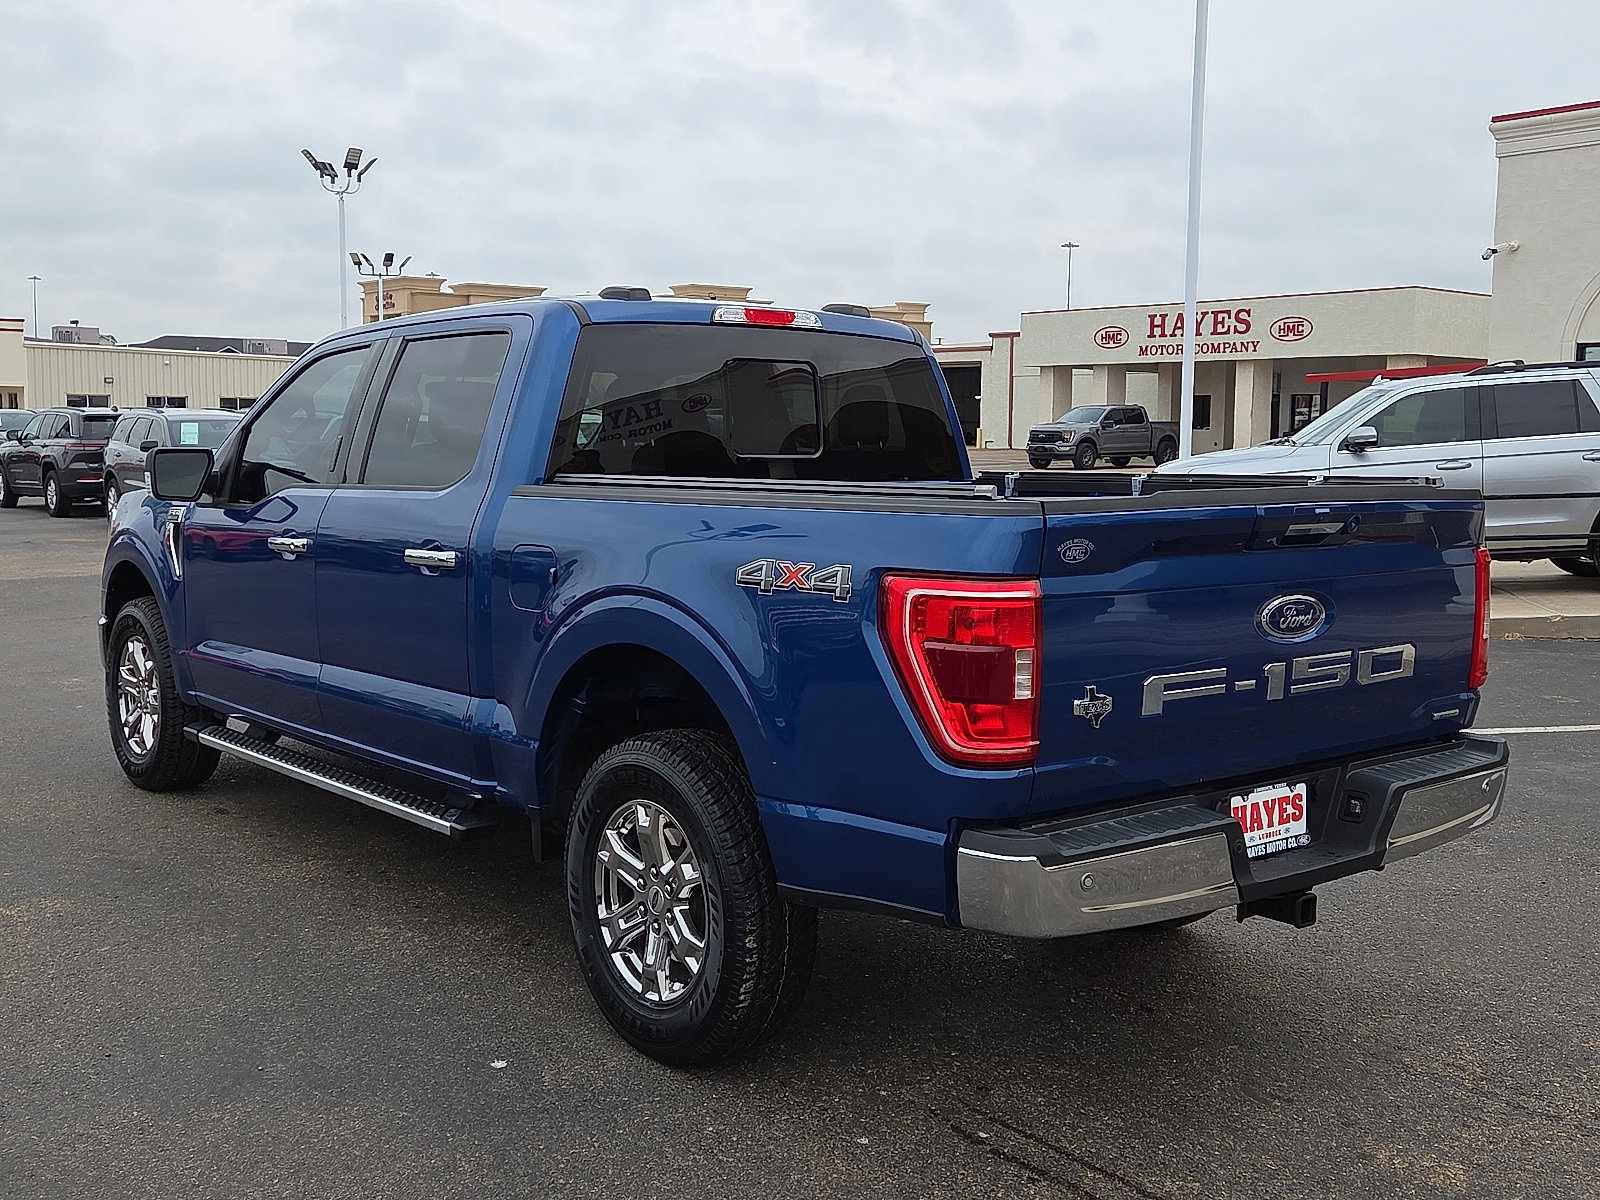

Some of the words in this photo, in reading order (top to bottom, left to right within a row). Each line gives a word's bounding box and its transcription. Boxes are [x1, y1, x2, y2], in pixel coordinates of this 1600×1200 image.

[1147, 308, 1252, 338] HAYES
[1278, 320, 1305, 337] HMC
[1100, 330, 1123, 345] HMC
[1138, 343, 1184, 356] MOTOR
[1195, 341, 1261, 354] COMPANY
[1065, 546, 1086, 560] HMC
[1278, 604, 1314, 629] Ford
[1140, 642, 1418, 717] F-150
[1080, 698, 1110, 715] TEXAS
[1232, 793, 1304, 833] HAYES
[1267, 839, 1287, 854] MOTOR
